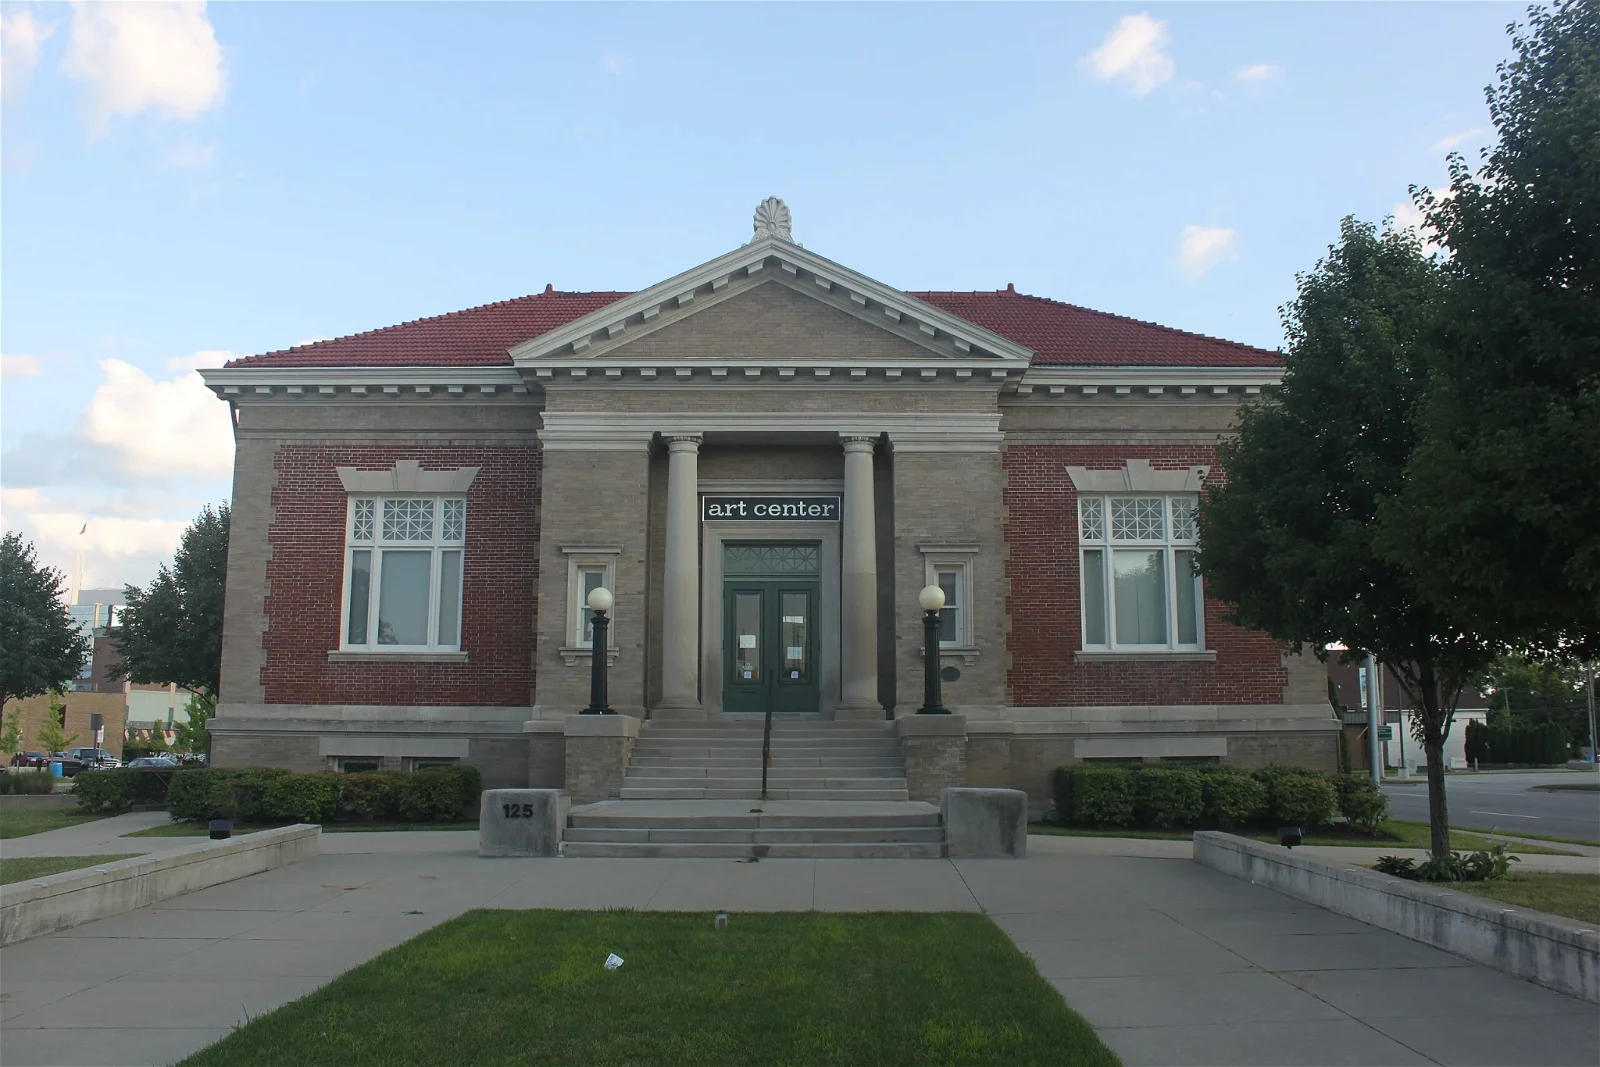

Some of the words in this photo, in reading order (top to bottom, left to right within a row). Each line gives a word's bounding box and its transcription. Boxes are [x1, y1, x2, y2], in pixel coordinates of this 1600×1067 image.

[708, 501, 747, 516] art
[753, 501, 835, 516] center
[503, 803, 534, 819] 125
